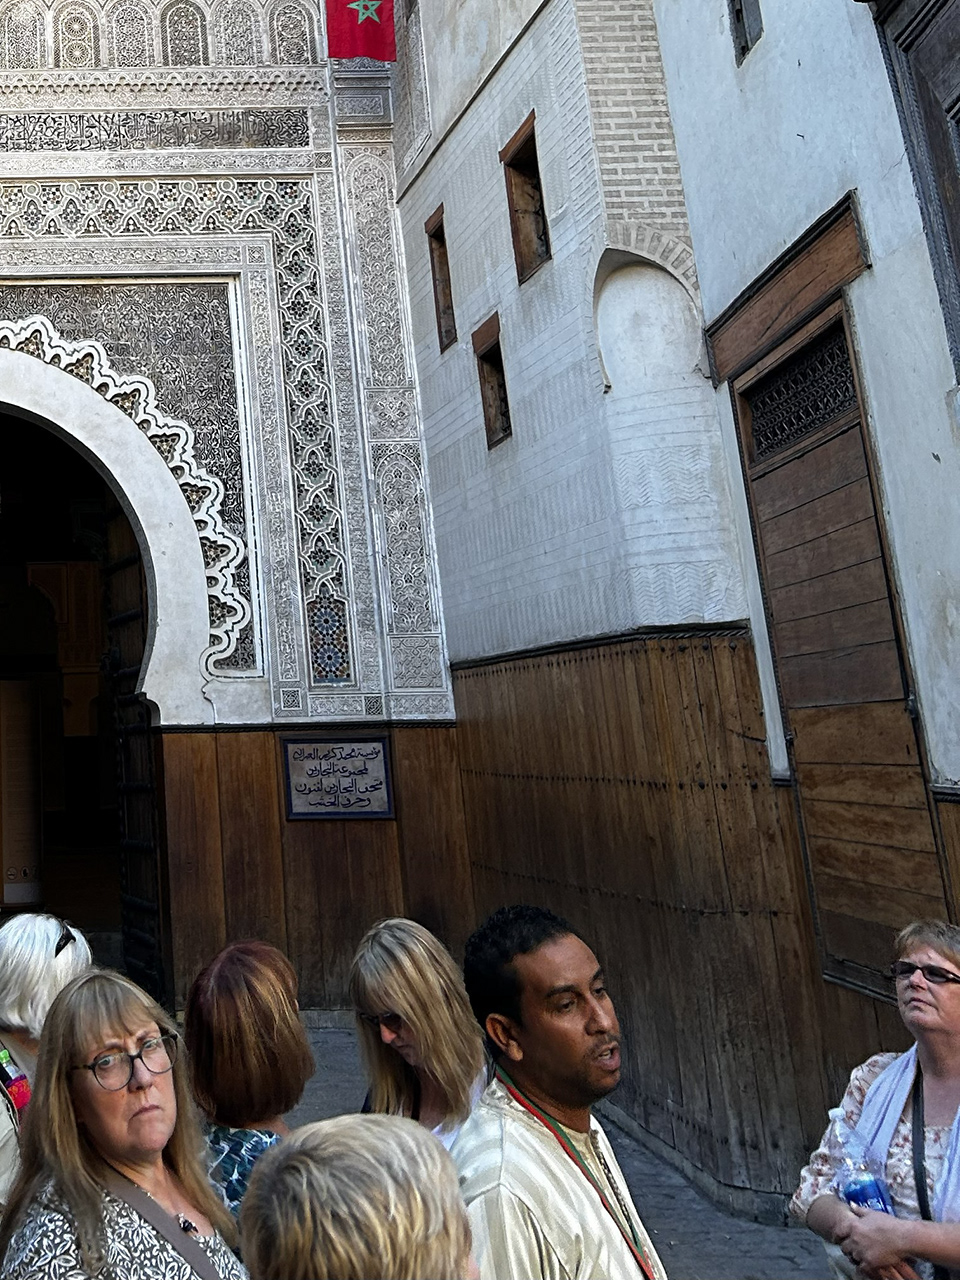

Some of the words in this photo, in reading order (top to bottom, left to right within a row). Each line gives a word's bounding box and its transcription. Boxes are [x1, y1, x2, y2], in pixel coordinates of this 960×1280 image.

[319, 746, 344, 761] كريم
[337, 747, 358, 760] محمد
[356, 747, 381, 759] مؤسسة
[306, 762, 335, 778] النجارين
[335, 760, 368, 778] لمجموعة
[324, 778, 357, 795] النجارين
[358, 779, 383, 793] متحف
[309, 795, 340, 808] الخشب
[340, 796, 371, 808] وحرف
